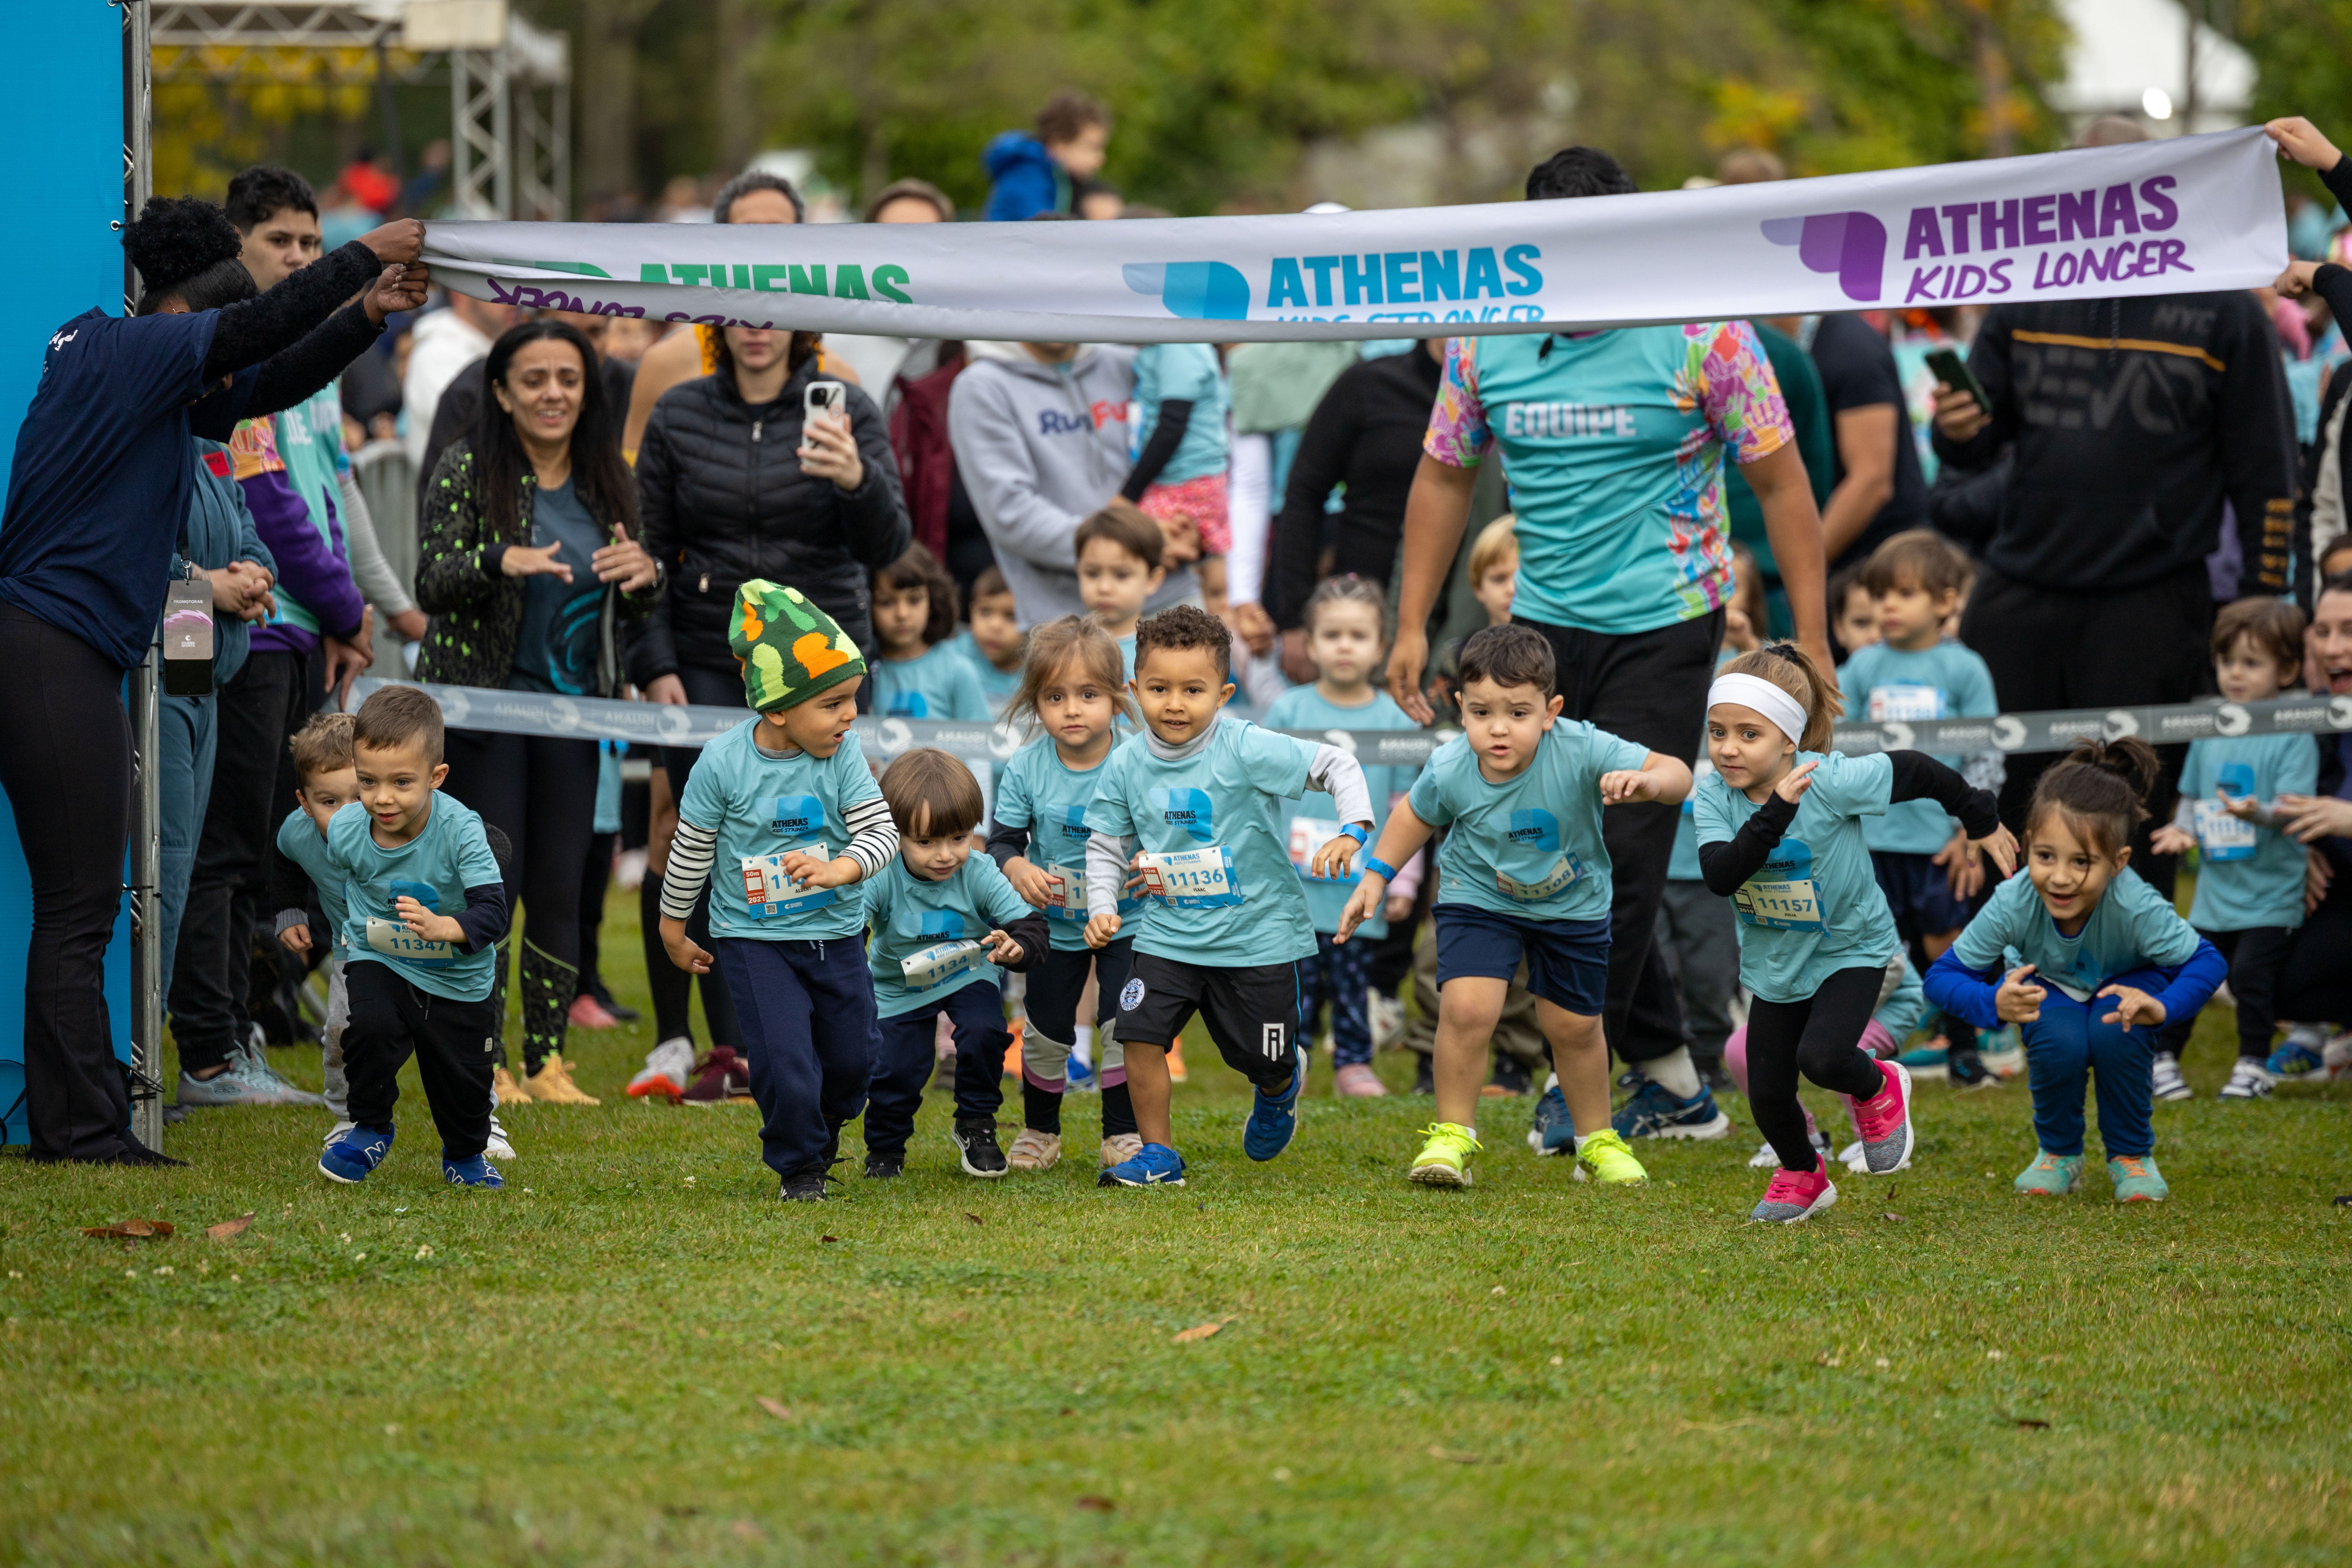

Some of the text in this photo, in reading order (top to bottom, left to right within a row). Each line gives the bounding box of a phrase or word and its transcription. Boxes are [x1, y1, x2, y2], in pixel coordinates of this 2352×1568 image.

[1903, 175, 2178, 260] ATHENAS
[1267, 244, 1543, 307] ATHENAS
[1904, 239, 2194, 304] KIDS LONGER
[1505, 402, 1636, 437] EQUIPE
[1165, 810, 1196, 820] ATHENAS
[772, 817, 808, 828] ATHENAS
[1062, 824, 1091, 833] ATHENA
[1509, 827, 1543, 838] ATHENAS
[1174, 853, 1200, 861] ATHENAS
[1167, 869, 1223, 886] 11136
[1758, 898, 1812, 912] 11157
[916, 931, 949, 941] ATHENAS
[390, 938, 446, 951] 11347
